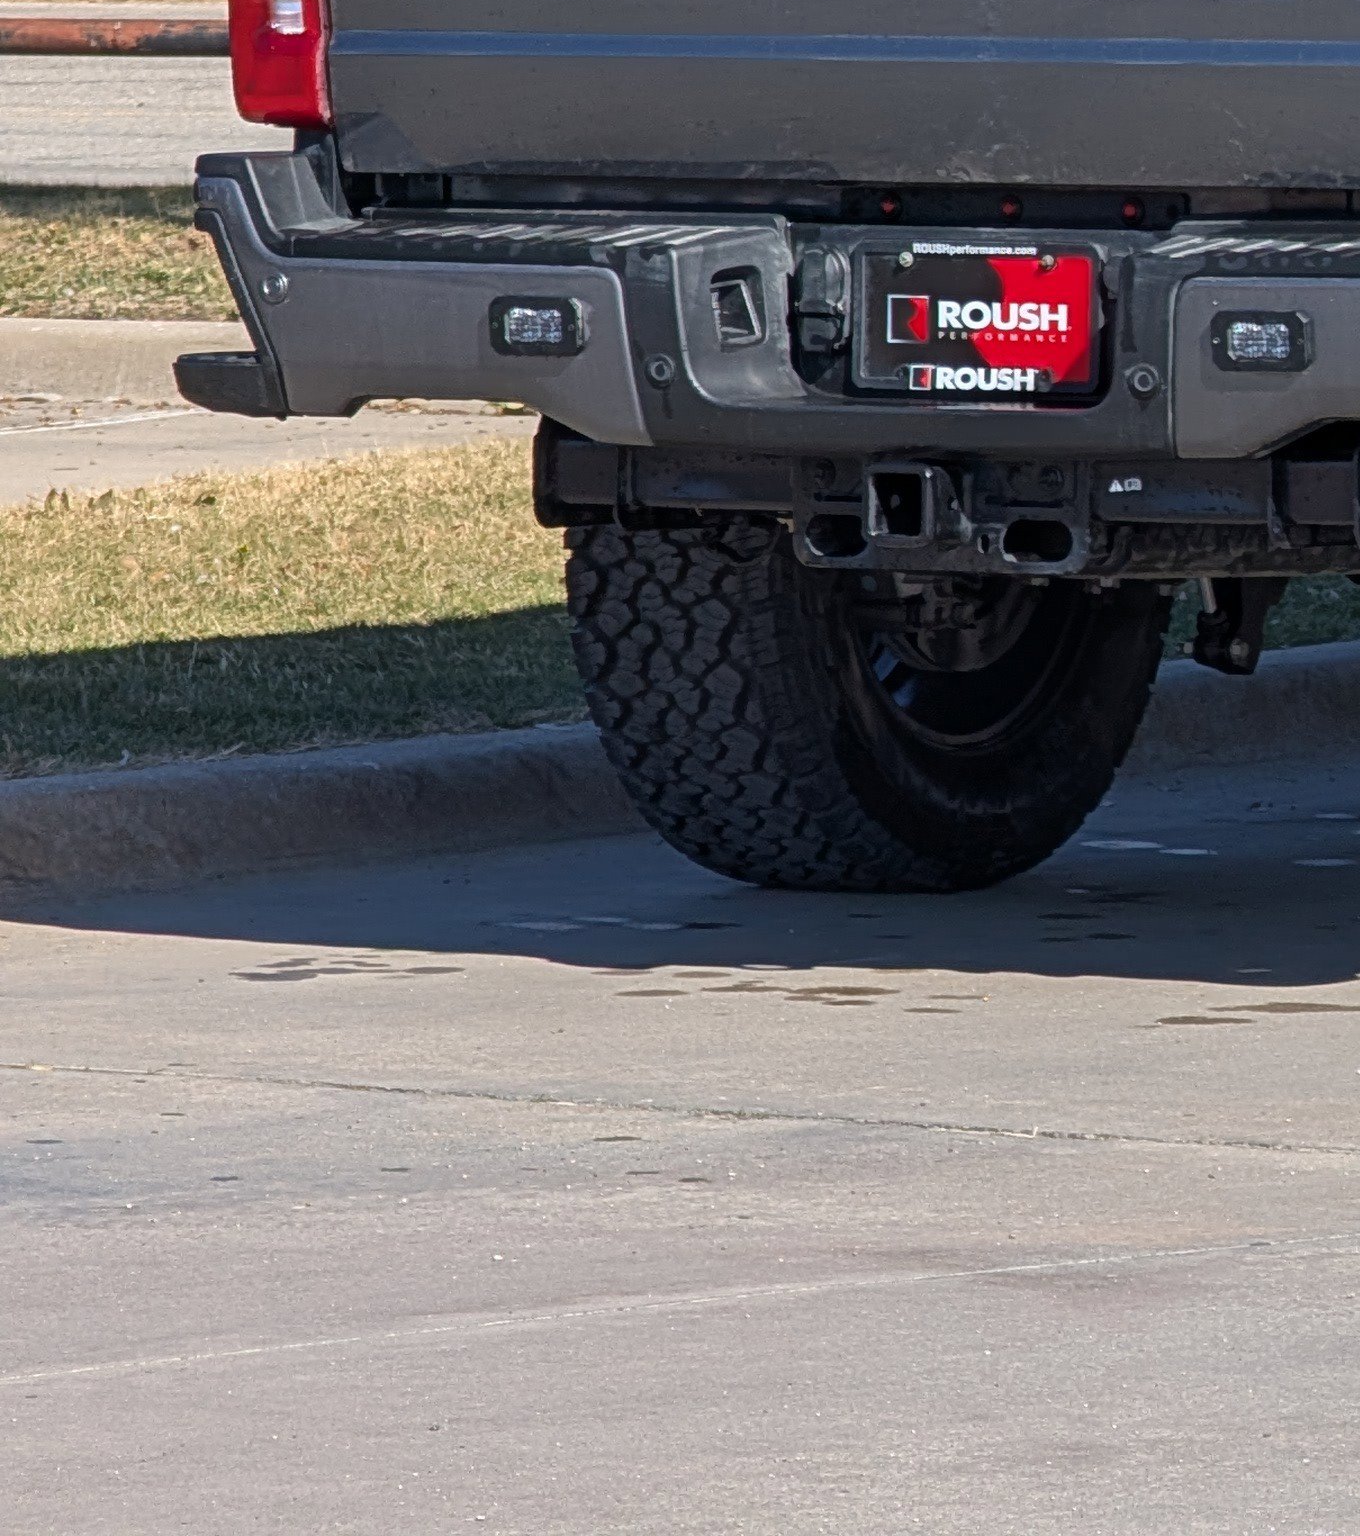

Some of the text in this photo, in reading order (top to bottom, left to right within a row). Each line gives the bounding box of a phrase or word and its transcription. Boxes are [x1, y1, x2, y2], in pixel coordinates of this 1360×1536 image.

[912, 242, 1038, 256] ROUSHperformance.com
[937, 300, 1069, 332] ROUSH
[938, 331, 1068, 344] PERFORMANCE
[936, 367, 1036, 392] ROUSH
